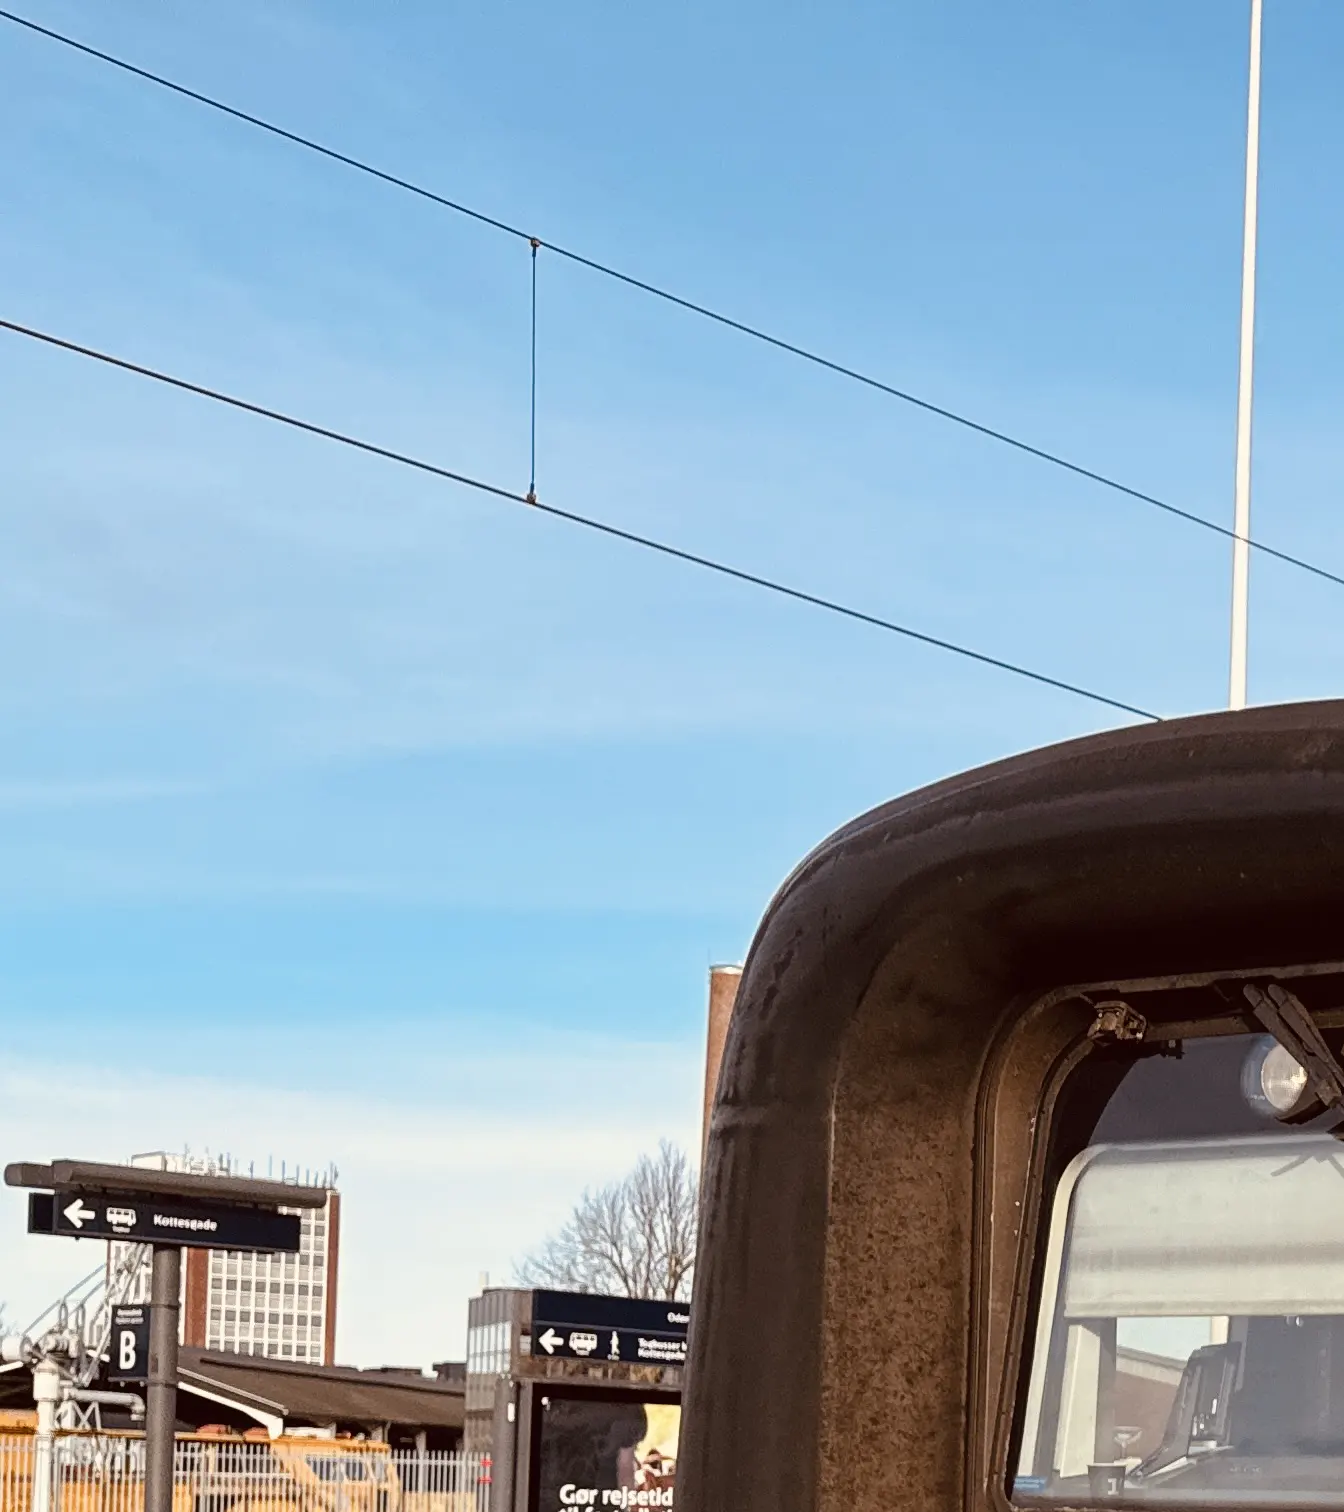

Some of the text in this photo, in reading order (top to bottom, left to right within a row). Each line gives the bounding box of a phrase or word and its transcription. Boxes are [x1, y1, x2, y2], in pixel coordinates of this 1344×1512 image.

[667, 1312, 689, 1323] Oden
[119, 1330, 136, 1370] B
[559, 1483, 674, 1510] Gør rejsetid
